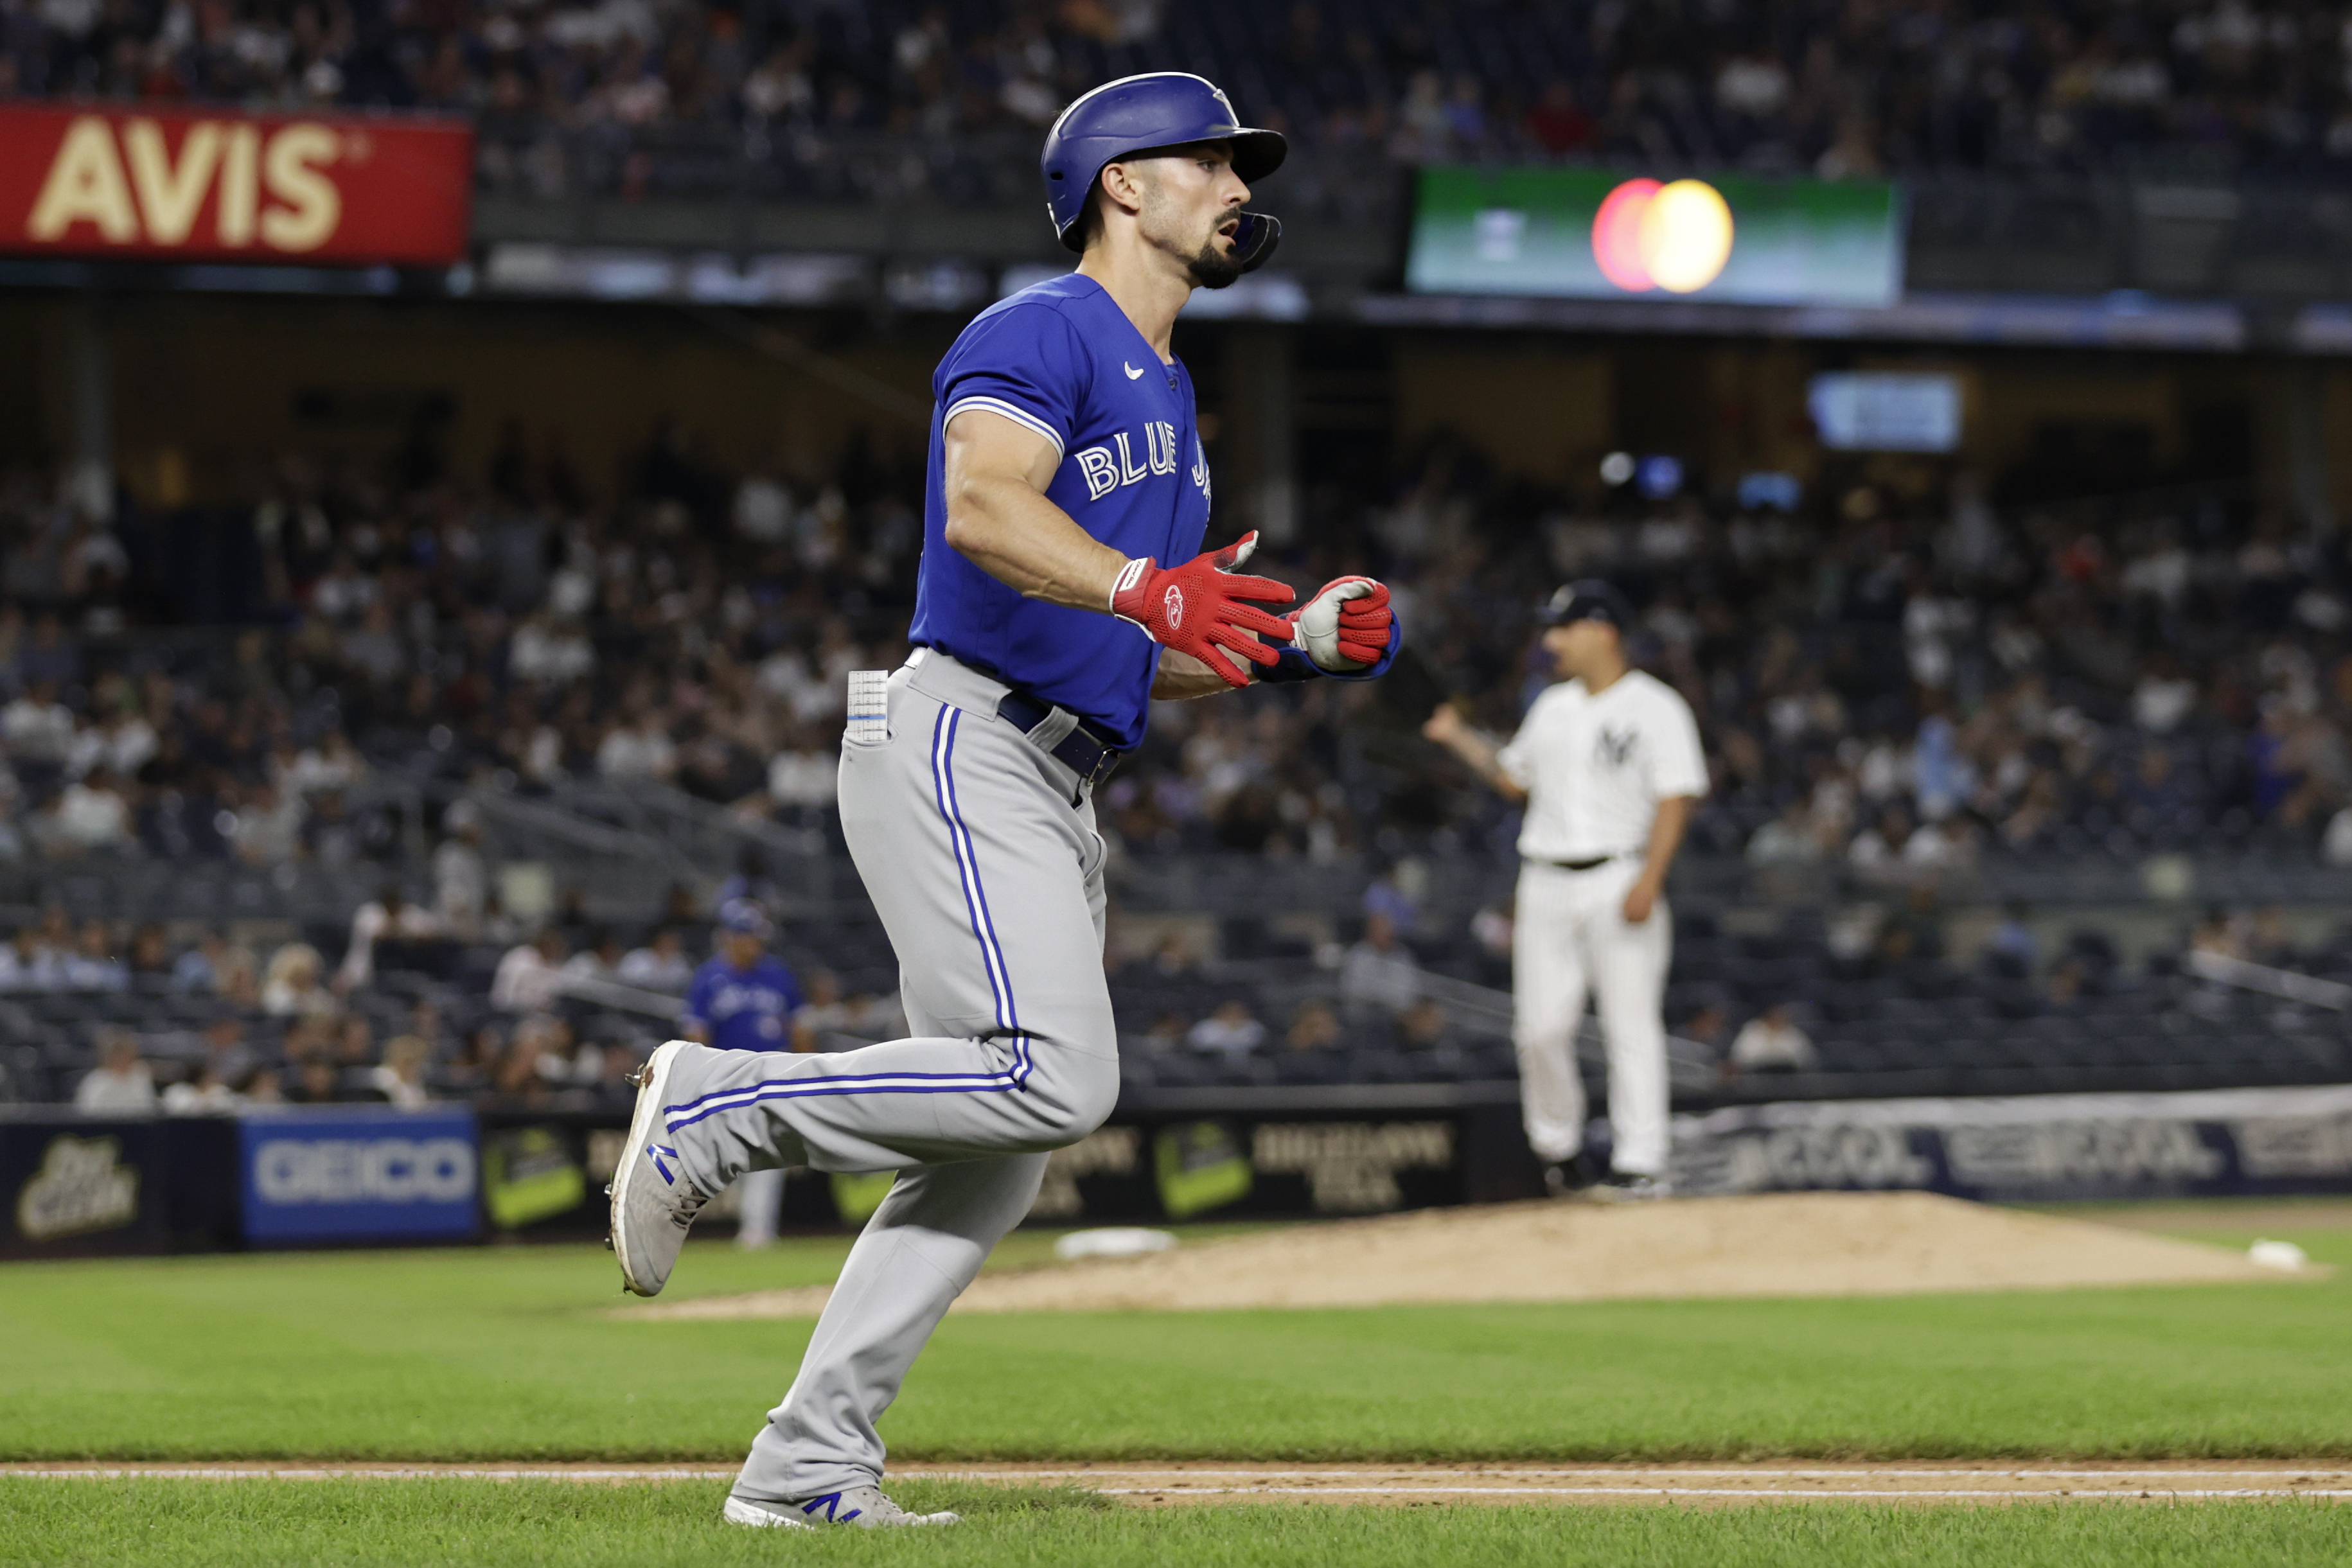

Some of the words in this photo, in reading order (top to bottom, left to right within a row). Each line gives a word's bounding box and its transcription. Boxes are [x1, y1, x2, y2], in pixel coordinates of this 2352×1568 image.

[28, 115, 341, 252] AVIS
[1074, 421, 1177, 502] BLUE
[258, 1138, 476, 1204] GEICO
